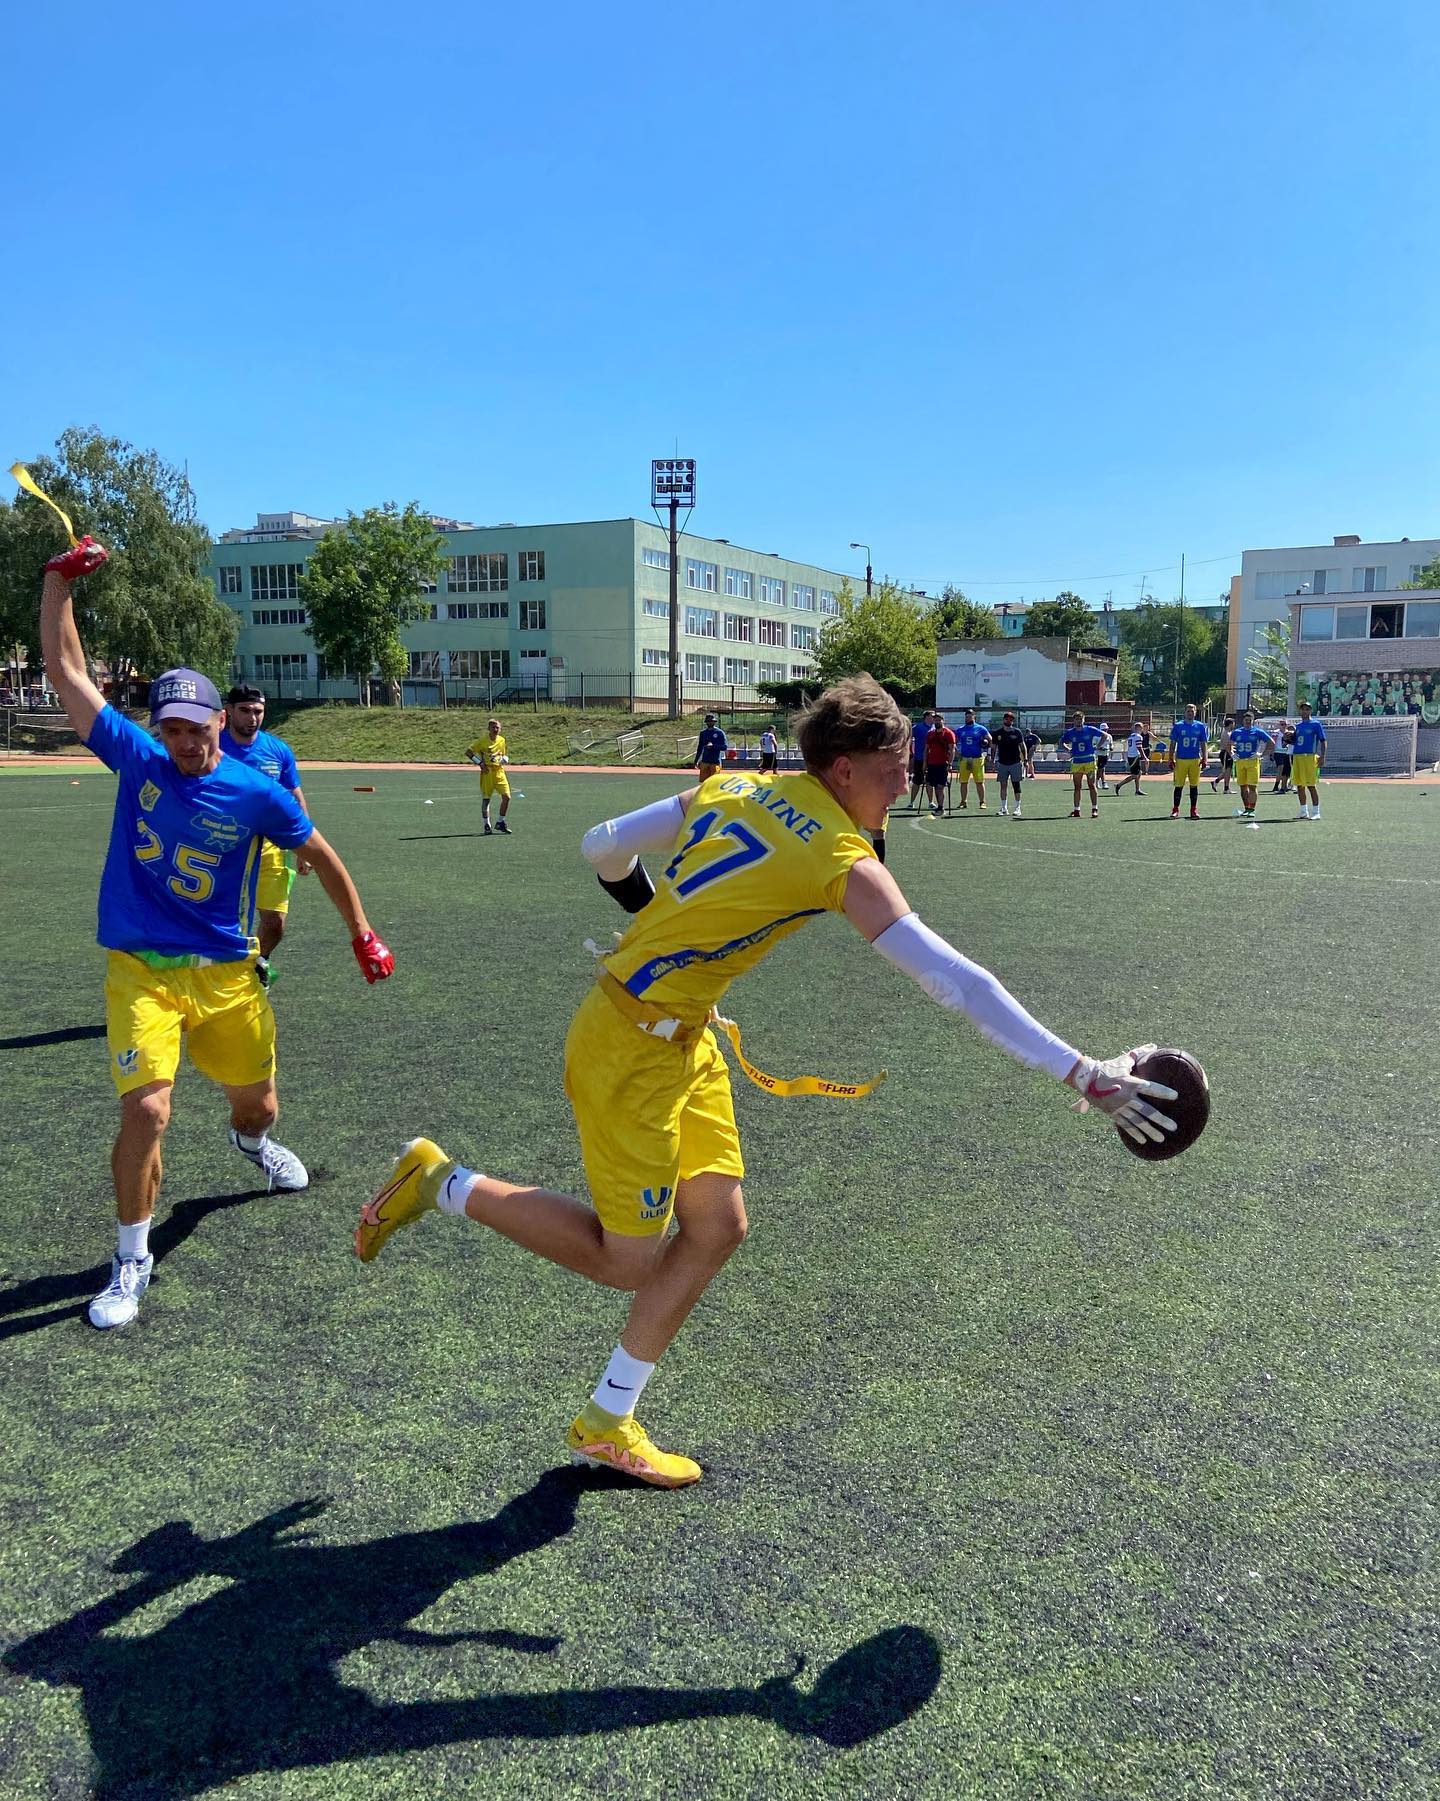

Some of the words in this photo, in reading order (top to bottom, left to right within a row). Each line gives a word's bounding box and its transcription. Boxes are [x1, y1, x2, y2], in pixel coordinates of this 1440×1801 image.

[159, 683, 196, 693] BEACH
[159, 691, 197, 701] GAMES
[133, 816, 222, 904] 25
[663, 806, 777, 904] 17
[748, 1068, 776, 1089] FLAG
[825, 1083, 857, 1095] FLAG
